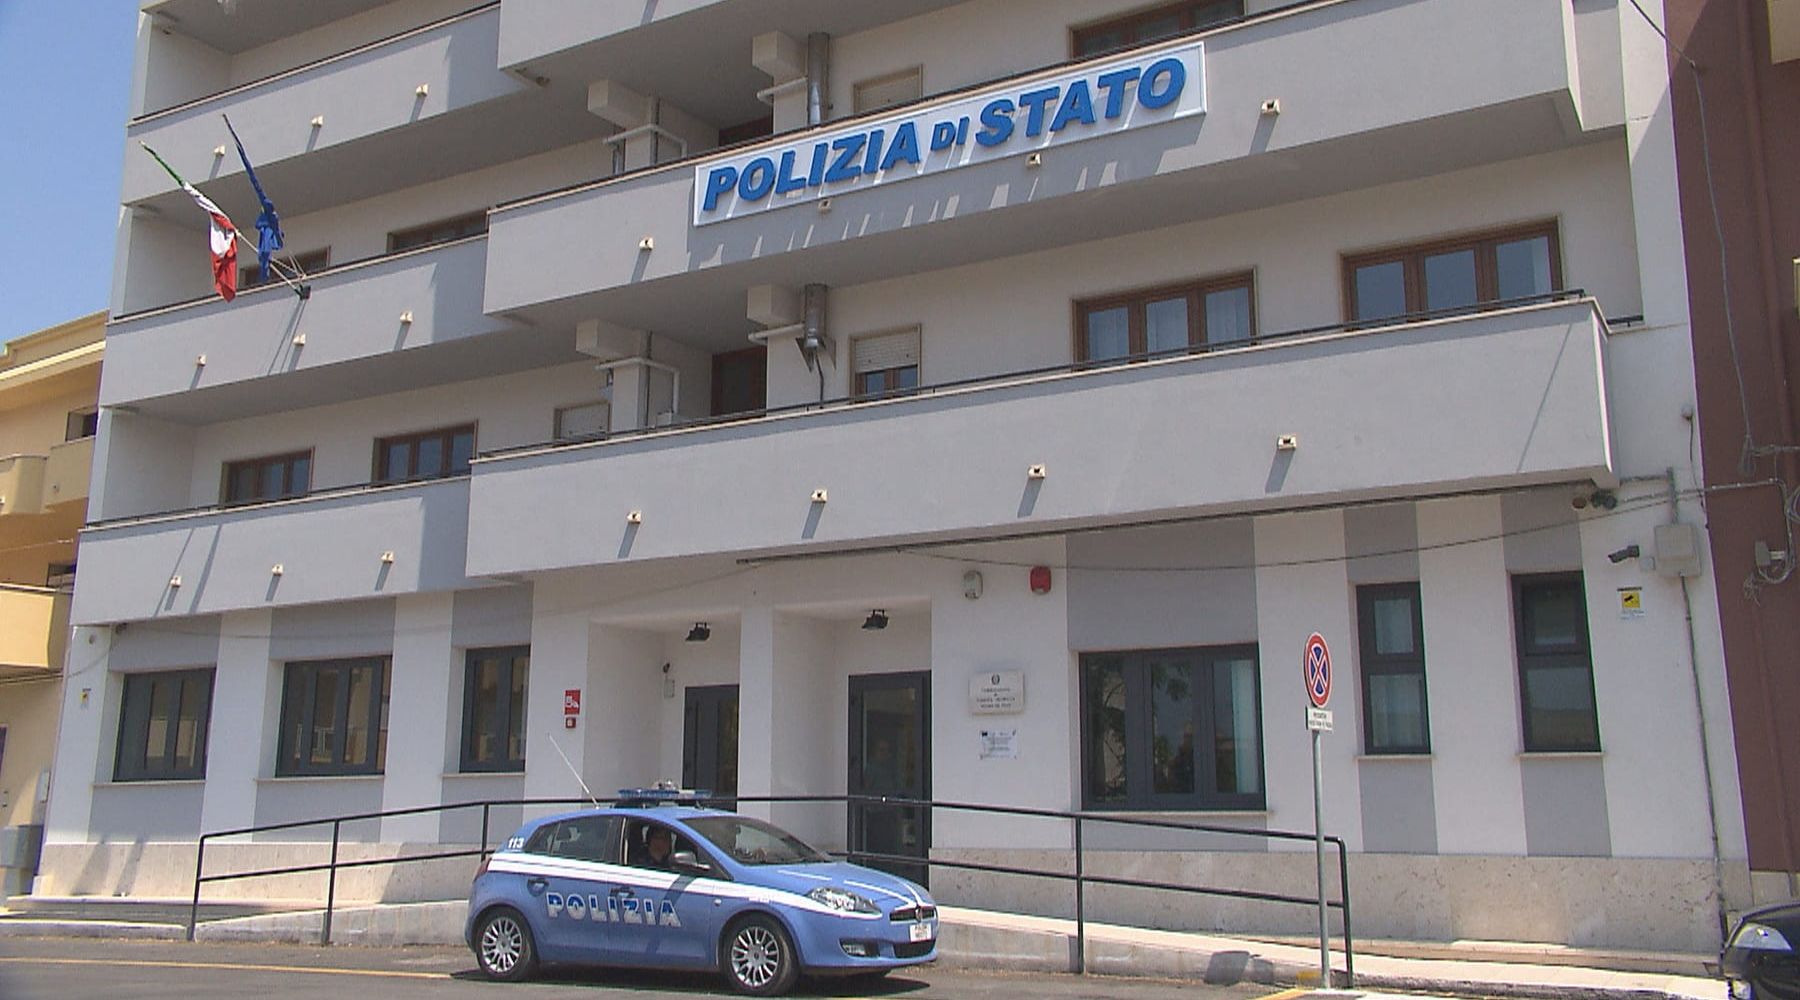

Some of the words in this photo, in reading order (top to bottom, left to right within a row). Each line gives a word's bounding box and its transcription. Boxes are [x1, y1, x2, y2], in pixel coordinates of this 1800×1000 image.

[703, 121, 920, 211] POLIZIA
[931, 117, 969, 151] DI
[975, 57, 1185, 147] STATO
[507, 837, 525, 849] 113
[546, 892, 681, 928] POLIZIA
